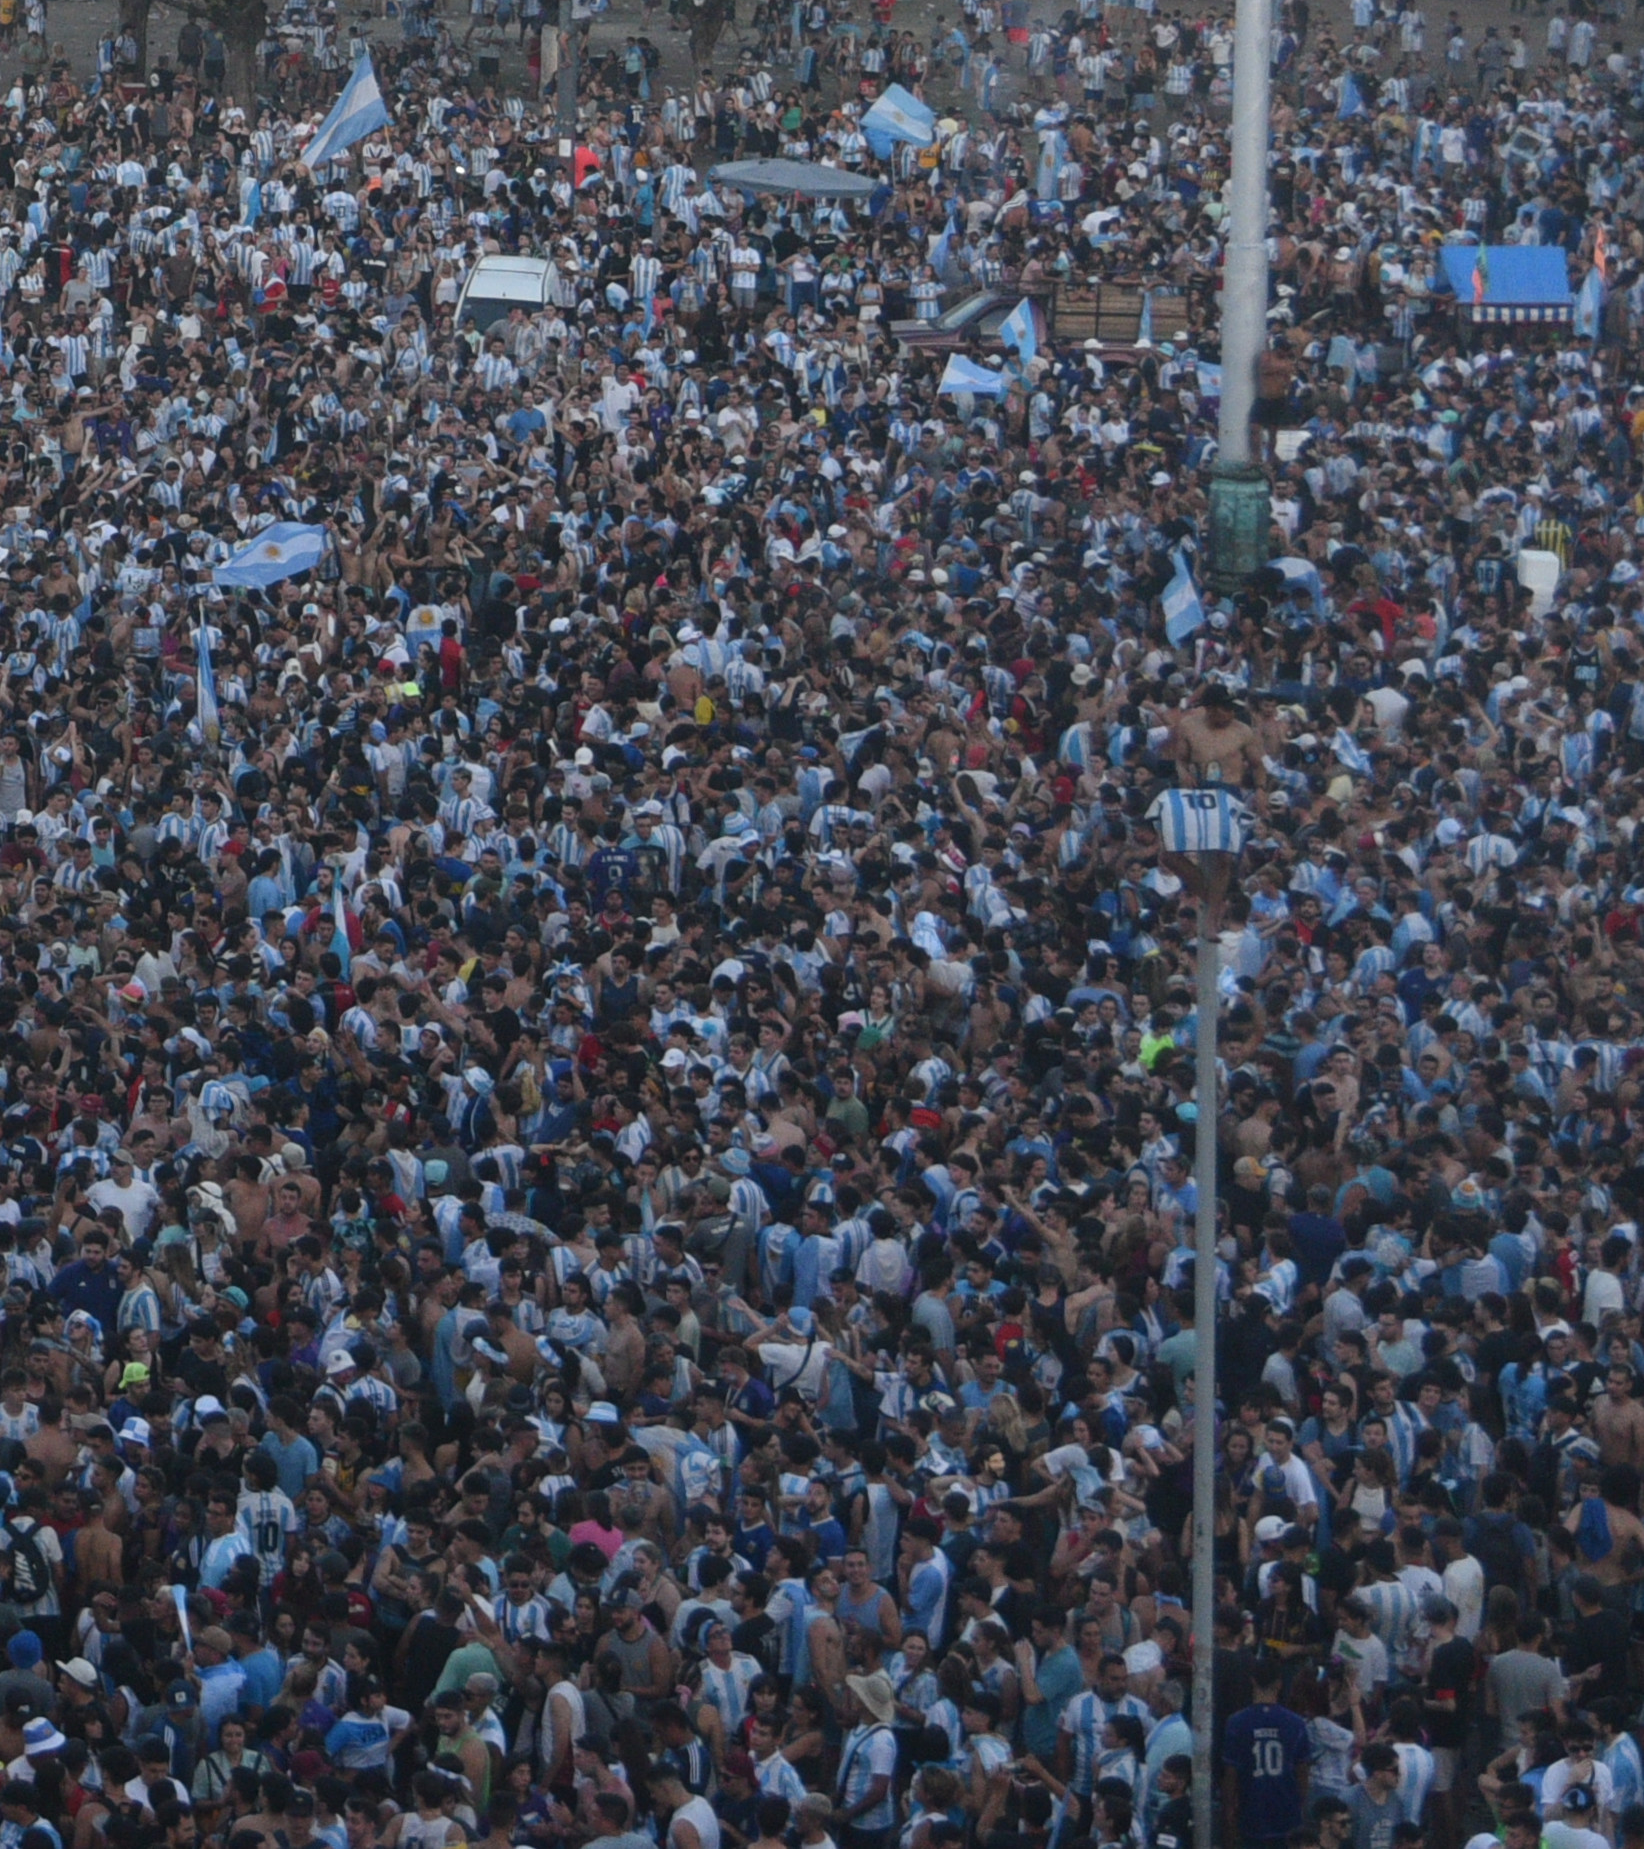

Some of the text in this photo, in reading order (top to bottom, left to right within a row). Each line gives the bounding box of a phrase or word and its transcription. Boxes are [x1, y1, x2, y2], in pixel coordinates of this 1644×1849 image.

[1182, 793, 1215, 810] 10
[252, 1520, 278, 1553] 10
[13, 1549, 37, 1592] NIKE
[1252, 1741, 1282, 1777] 10
